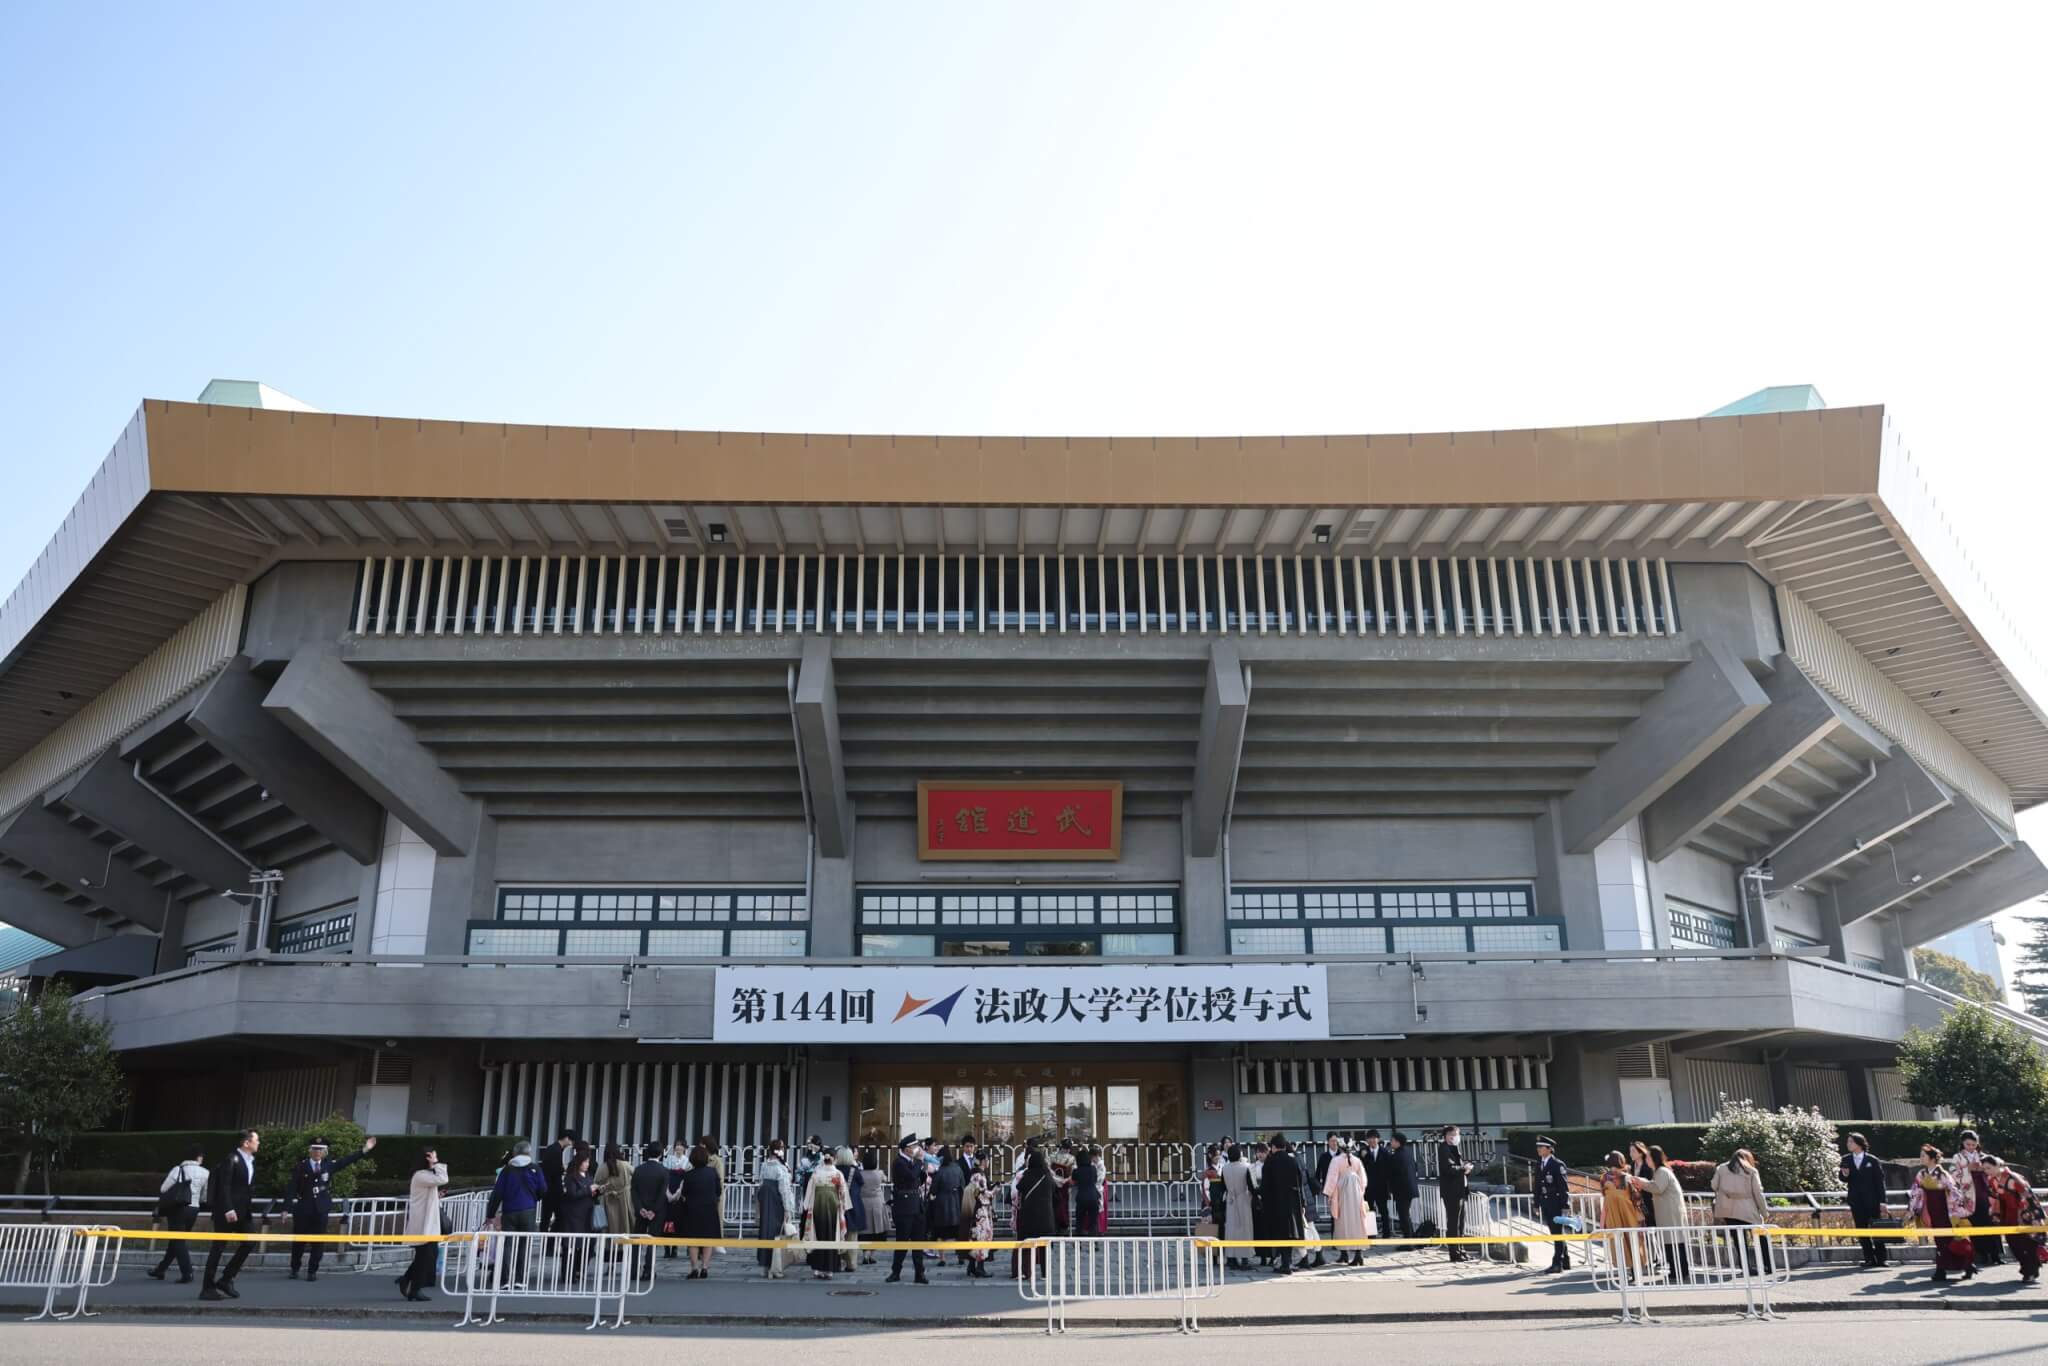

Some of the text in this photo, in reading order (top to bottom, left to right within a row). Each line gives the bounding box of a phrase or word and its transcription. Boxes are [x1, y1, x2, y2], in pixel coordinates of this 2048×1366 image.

[731, 985, 1313, 1025] 第144回 法政大学学位授与式
